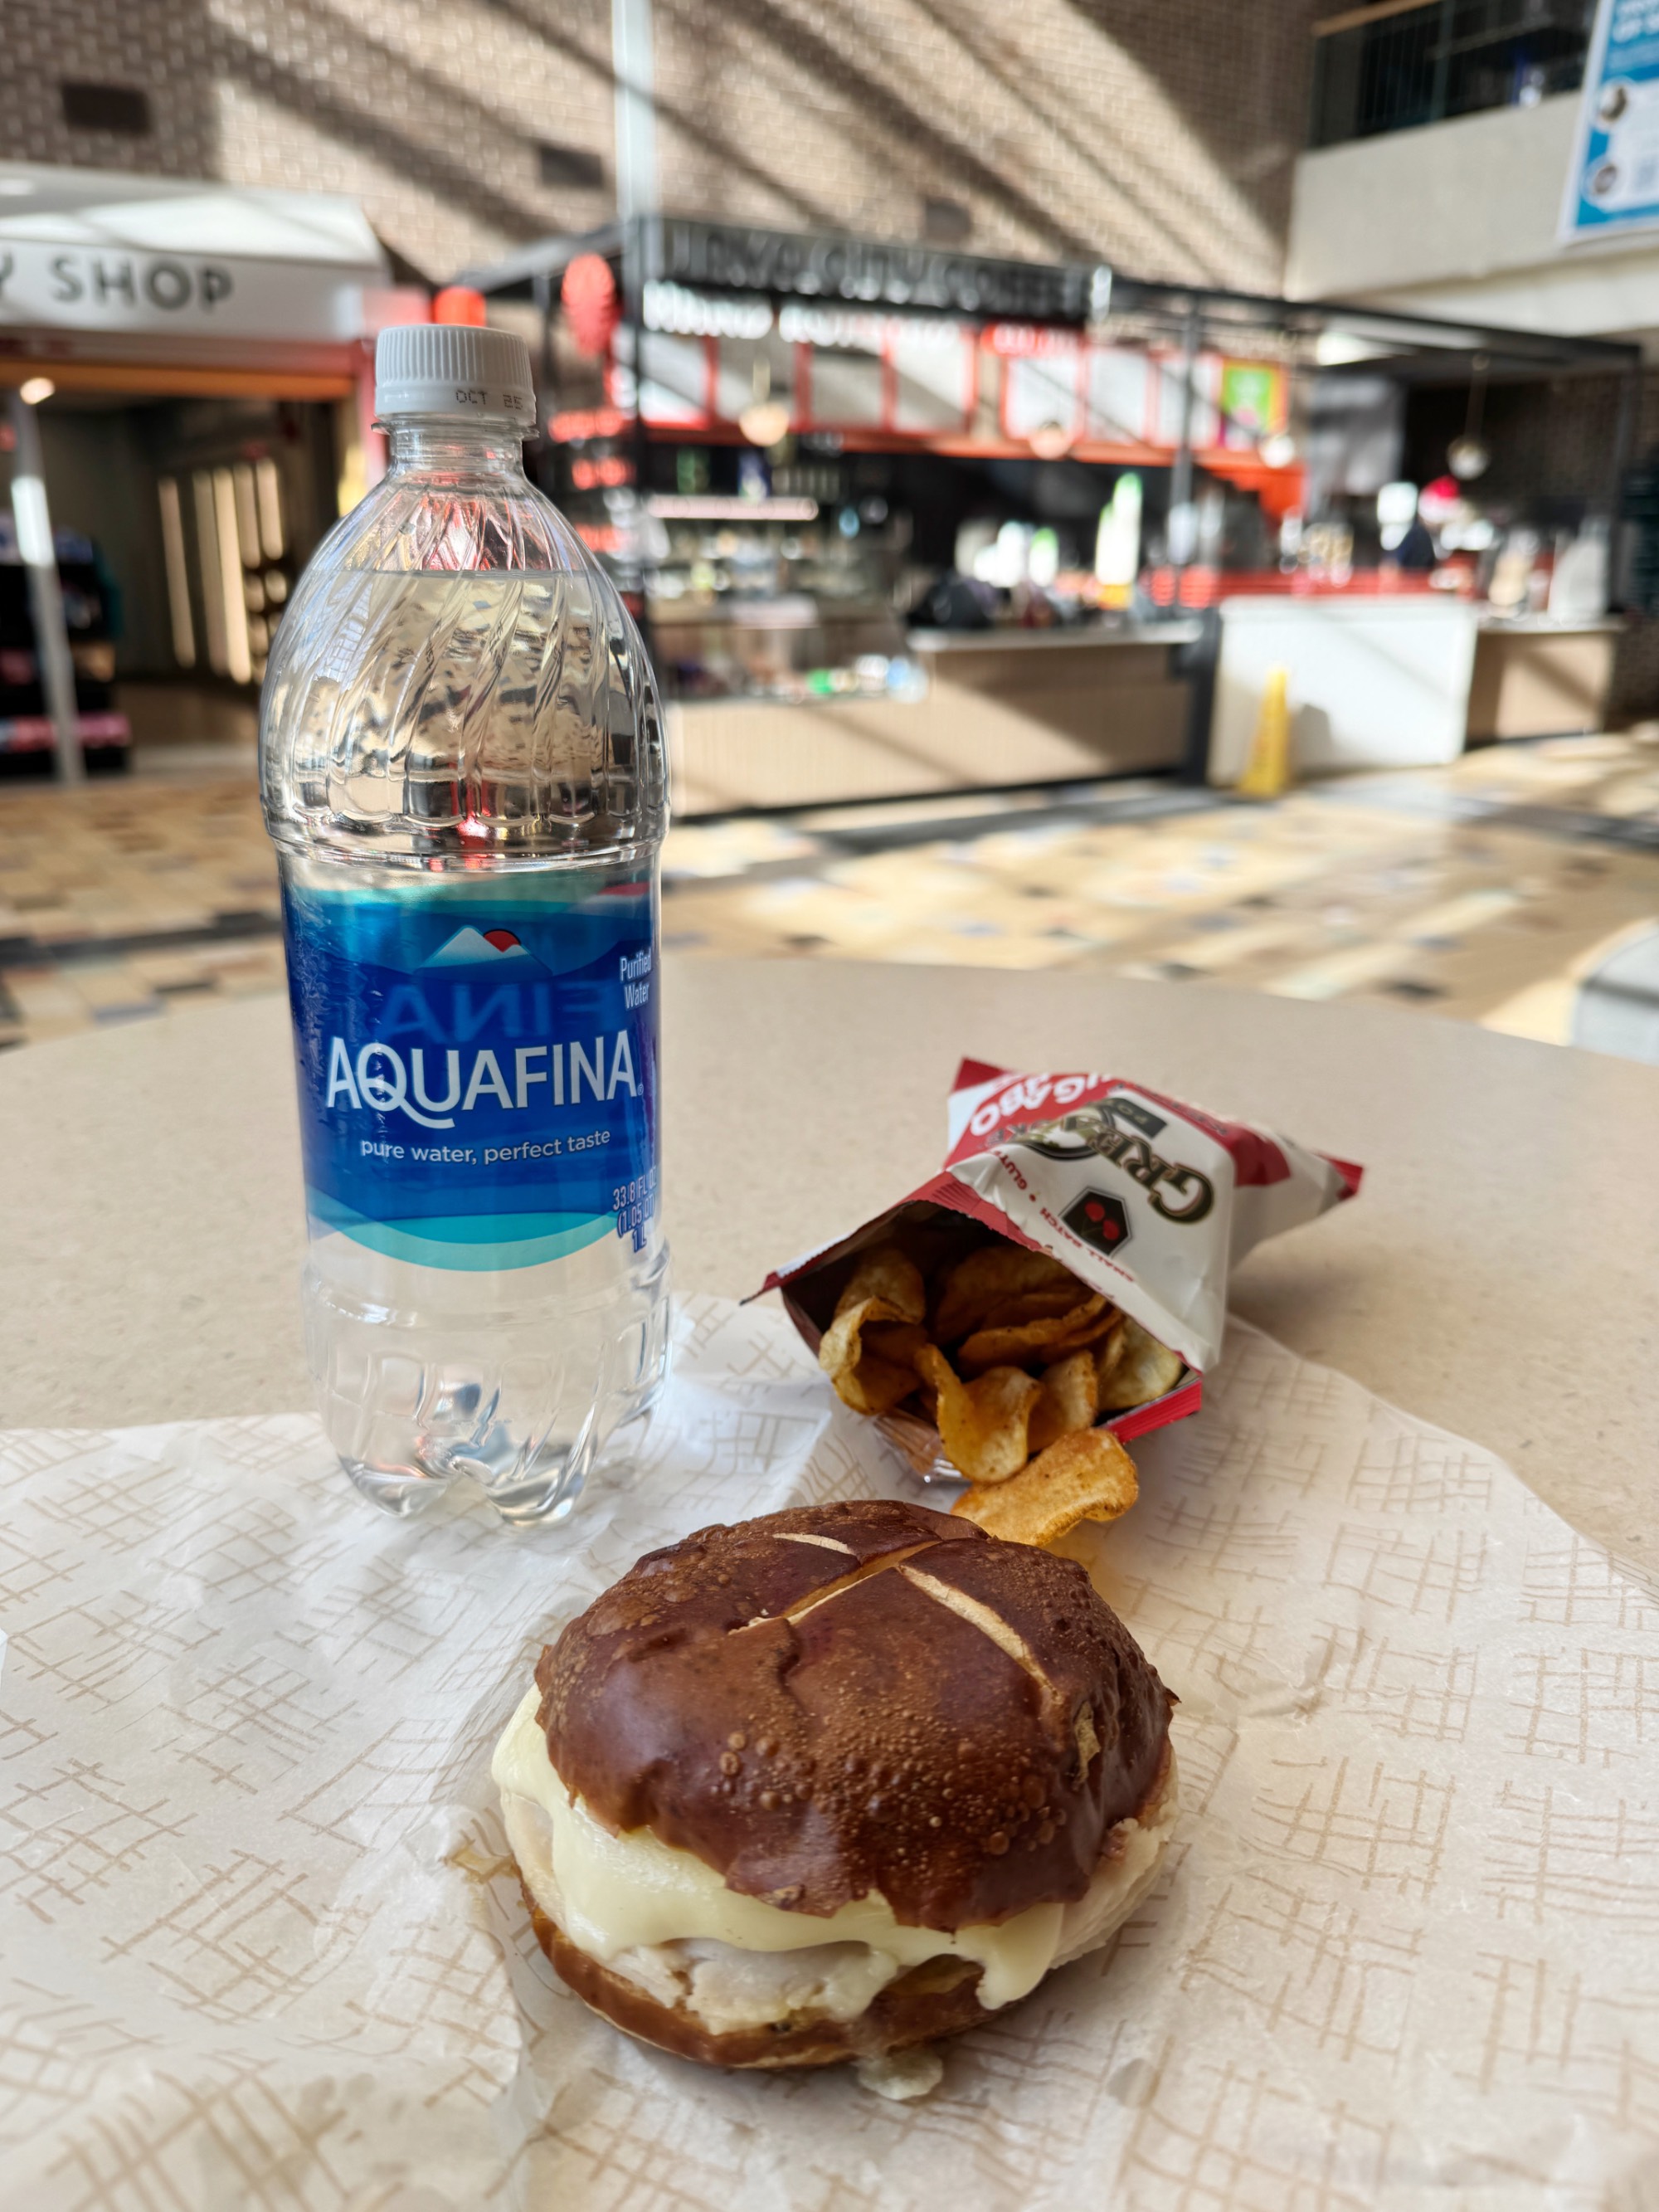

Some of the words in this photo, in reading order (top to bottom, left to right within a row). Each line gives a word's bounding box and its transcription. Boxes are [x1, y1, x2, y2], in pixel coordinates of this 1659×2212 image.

[50, 256, 234, 314] SHOP
[455, 390, 488, 405] OCT
[619, 948, 651, 982] Purified
[625, 982, 649, 1009] Water
[327, 1030, 636, 1128] AQUAFINA
[361, 1140, 405, 1158] pure
[411, 1146, 477, 1165] water,
[484, 1138, 562, 1166] perfect
[567, 1128, 611, 1152] taste
[613, 1182, 635, 1211] 33.8
[638, 1175, 647, 1198] FL
[617, 1202, 642, 1238] (1.05
[1039, 1207, 1082, 1248] BATCH
